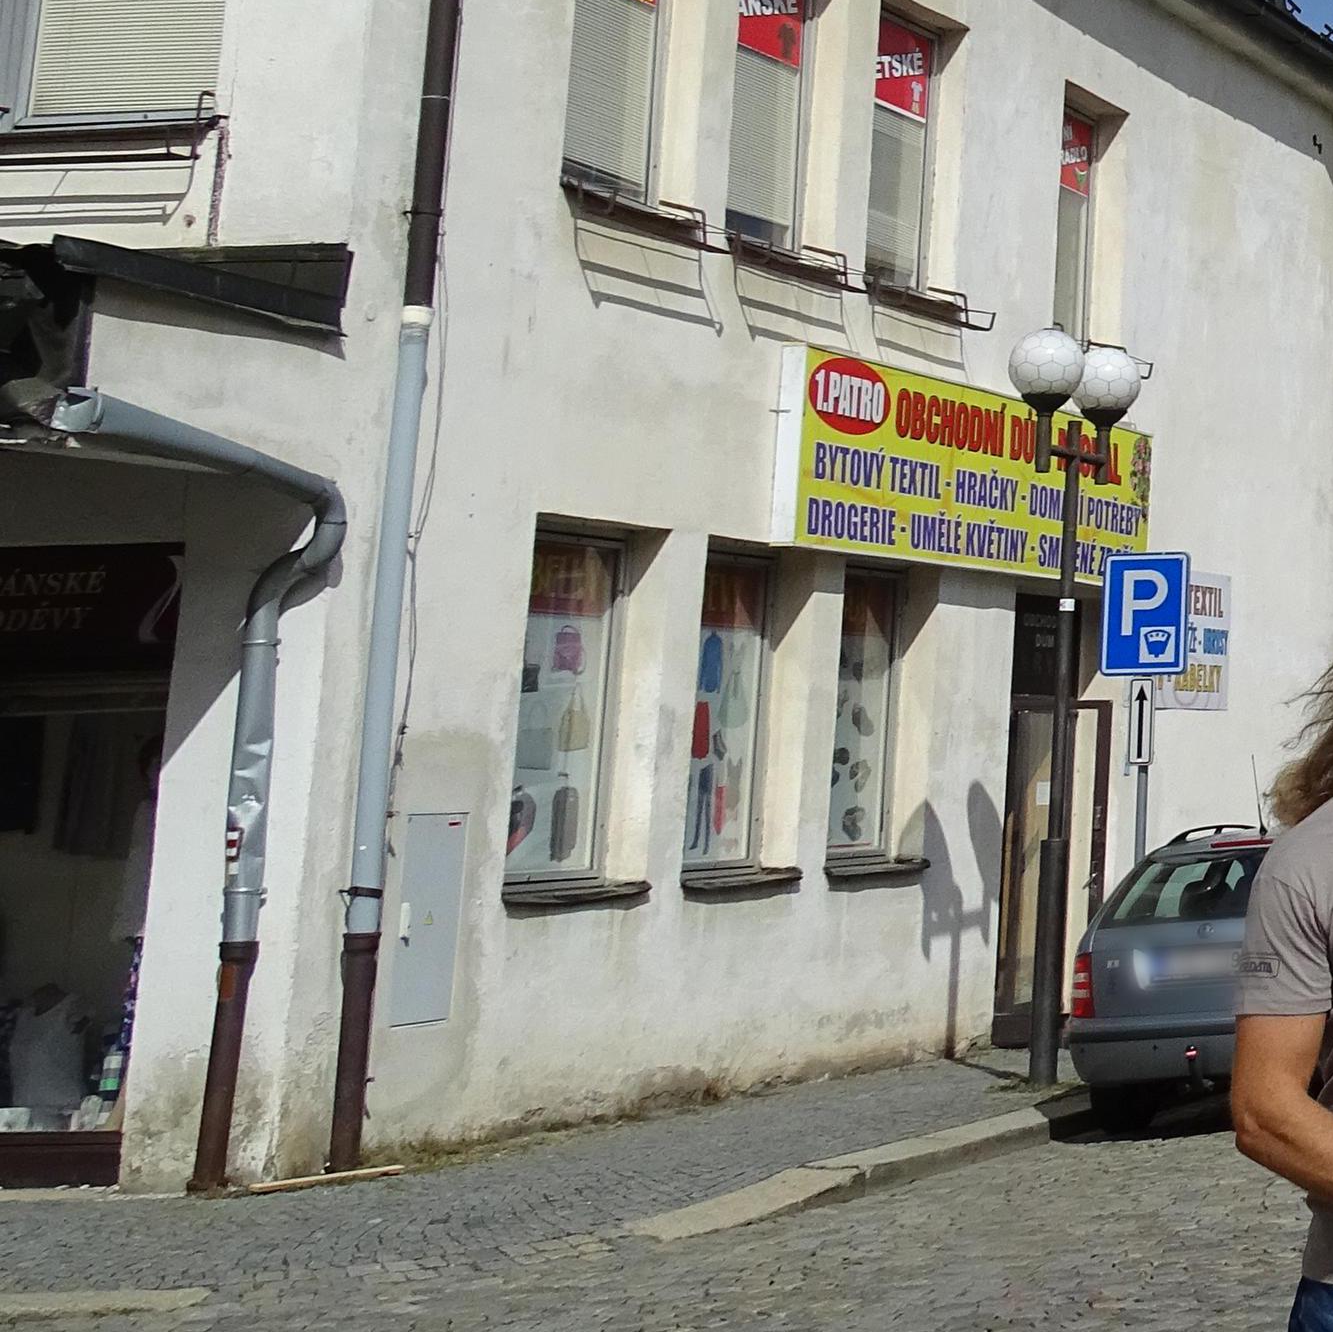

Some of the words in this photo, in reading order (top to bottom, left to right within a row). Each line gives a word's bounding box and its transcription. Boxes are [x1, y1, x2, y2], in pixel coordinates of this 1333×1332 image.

[815, 369, 886, 425] 1.PATRO
[895, 388, 1007, 458] OBCHODNÍ
[814, 441, 886, 490] BYTOVÝ
[890, 456, 941, 499] TEXTIL
[955, 469, 1019, 512] HRAČKY
[1029, 483, 1085, 526] DOMÍ
[1087, 496, 1142, 537] POTŘEBY
[807, 497, 896, 546] DROGERIE
[910, 511, 962, 555] UMĚLÉ
[966, 519, 1028, 564] KVĚTINY
[1038, 534, 1096, 576] SMENÉ
[0, 565, 106, 596] ÁNSKÉ
[1120, 569, 1168, 636] P
